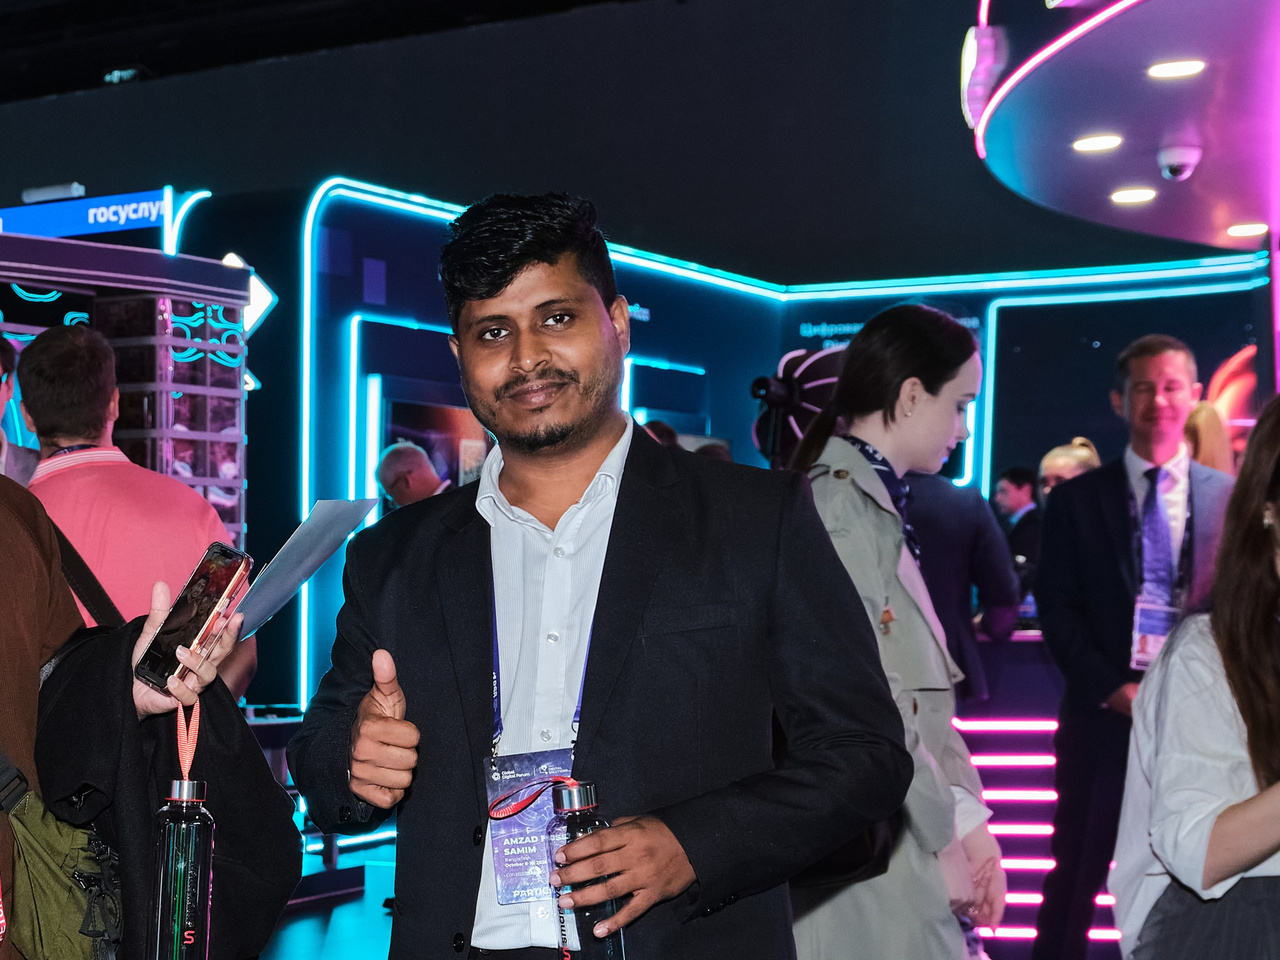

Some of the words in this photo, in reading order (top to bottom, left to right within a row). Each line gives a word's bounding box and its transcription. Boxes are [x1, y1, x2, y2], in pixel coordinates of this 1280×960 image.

[503, 835, 538, 846] AMZAD
[503, 846, 537, 856] SAMIM
[513, 888, 552, 898] PARTIC
